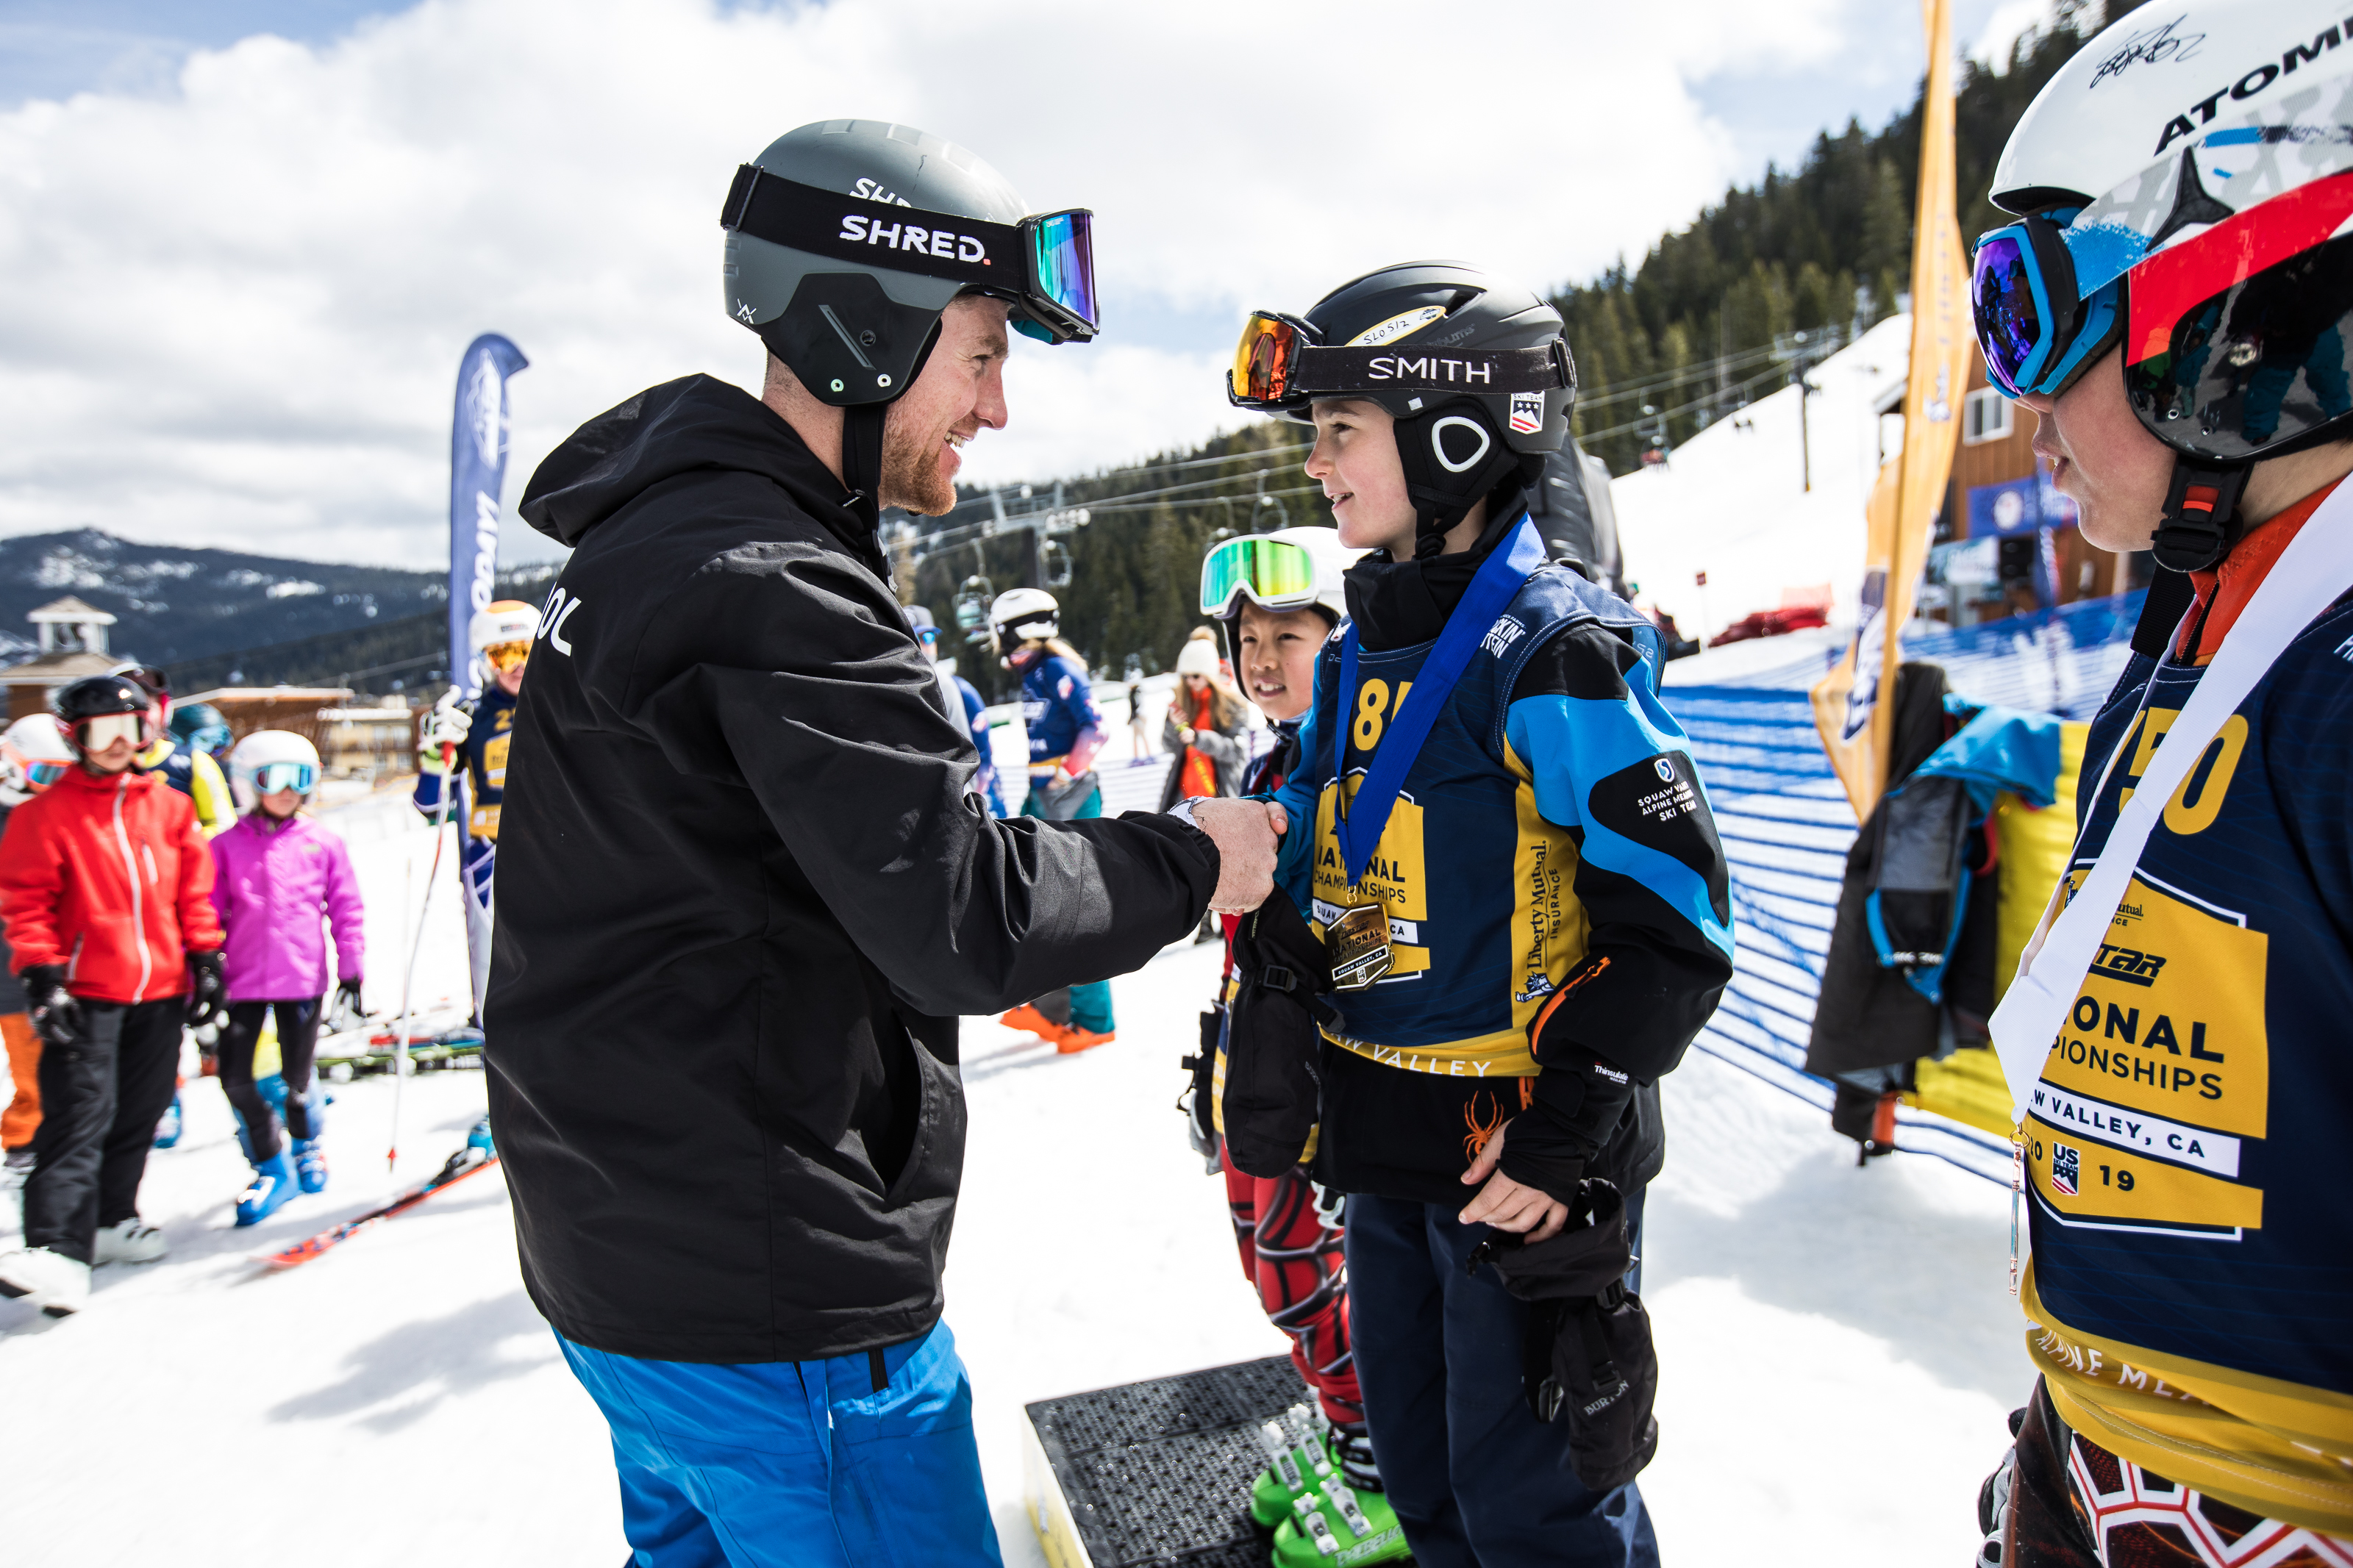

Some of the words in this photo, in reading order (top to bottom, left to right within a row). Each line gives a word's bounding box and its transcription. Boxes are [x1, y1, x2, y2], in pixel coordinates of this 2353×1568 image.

[839, 215, 991, 265] SHRED.
[1368, 357, 1490, 384] SMITH
[1354, 679, 1413, 751] 8
[1638, 787, 1674, 807] SQUAW
[1642, 798, 1673, 815] ALPINE
[1659, 807, 1677, 822] SKI
[1548, 867, 1562, 939] INSURANCE
[1333, 928, 1382, 956] NATIONAL
[1390, 924, 1405, 936] CA
[1527, 909, 1551, 969] Liberty
[1338, 964, 1354, 975] SQUAW
[1374, 1044, 1491, 1078] VALLEY
[2053, 1142, 2079, 1165] US
[2166, 1133, 2205, 1159] CA
[2099, 1164, 2135, 1192] 19
[2035, 1329, 2102, 1377] ALPINE
